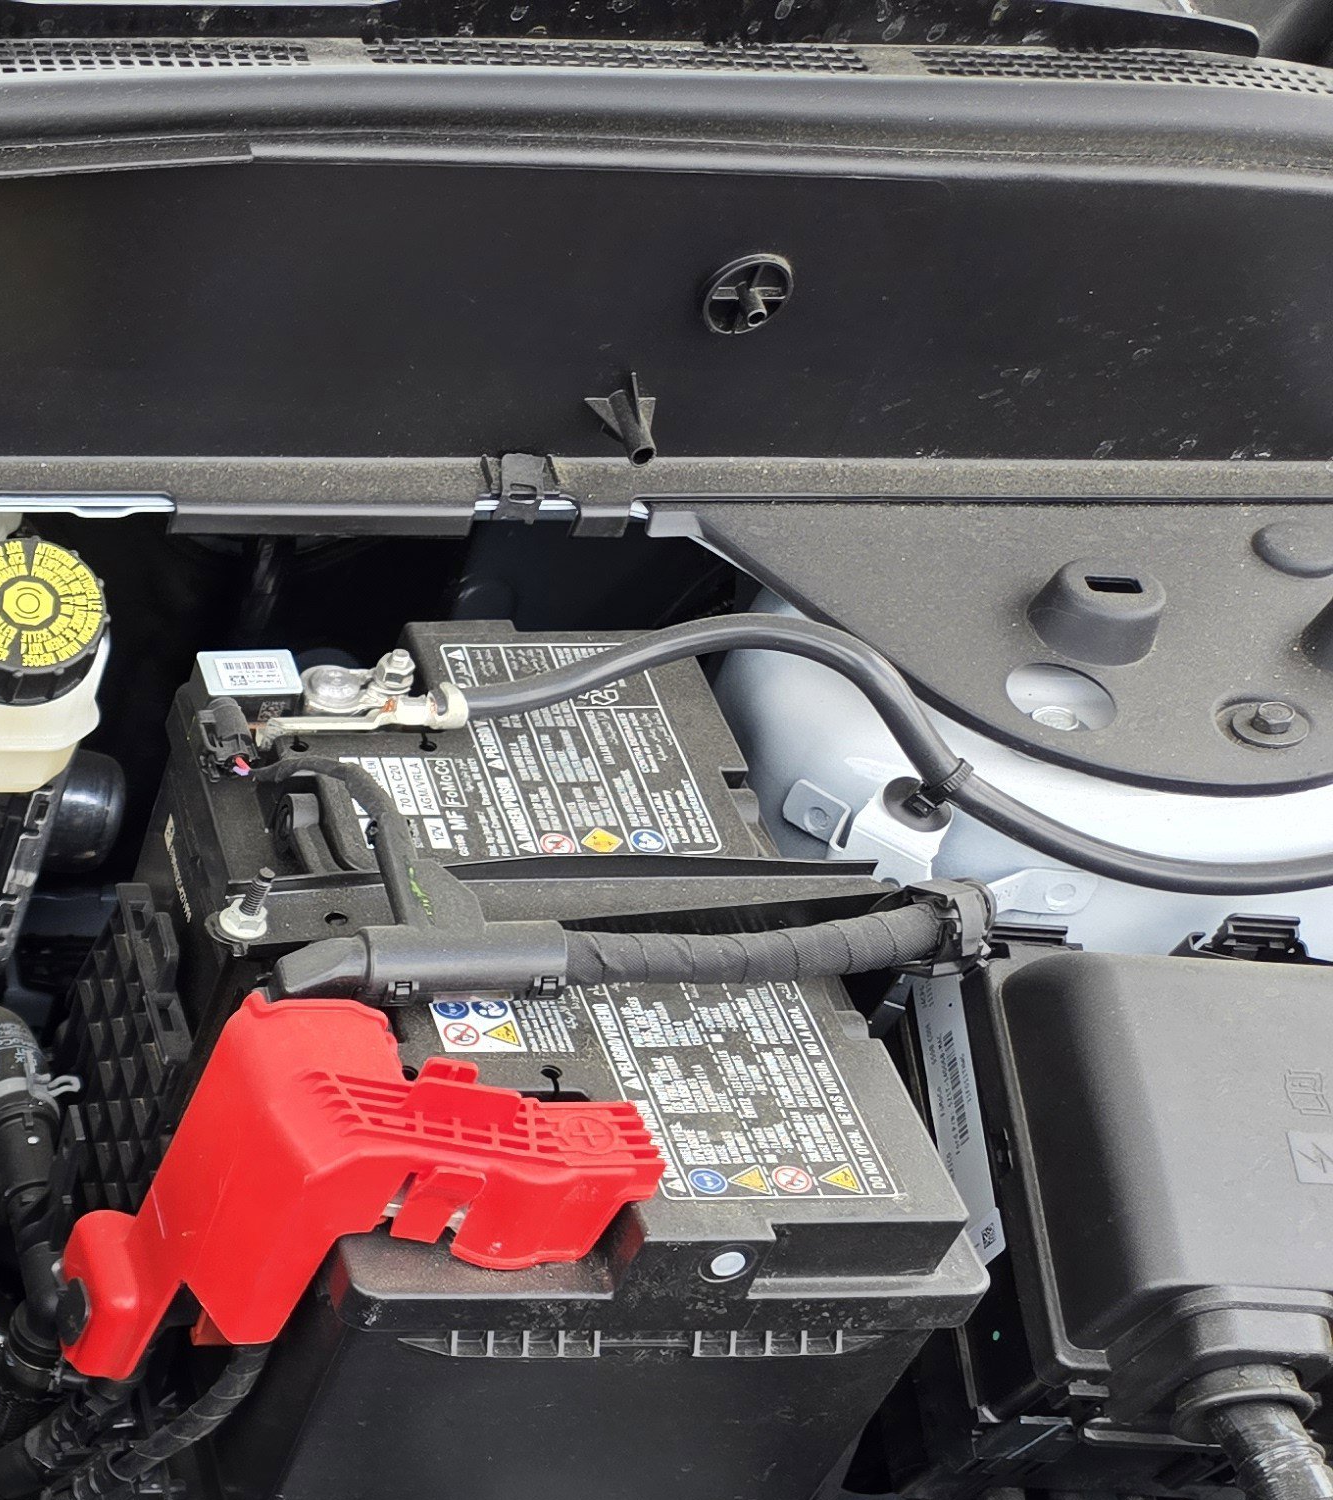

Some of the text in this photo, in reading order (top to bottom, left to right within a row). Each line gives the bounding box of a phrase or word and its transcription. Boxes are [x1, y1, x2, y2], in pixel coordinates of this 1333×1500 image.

[388, 765, 402, 780] C20
[431, 759, 456, 804] FoMoCo
[408, 762, 434, 810] AGM/VRLA
[399, 798, 412, 807] 70
[493, 776, 533, 840] DANGER/POISON
[444, 810, 468, 830] MF
[429, 824, 445, 840] 12V
[785, 1005, 810, 1029] ABRA.
[590, 1003, 637, 1076] PELIGRO/VENENO
[797, 1031, 815, 1041] LA
[803, 1043, 822, 1055] NO
[811, 1059, 840, 1093] OUVRIR.
[828, 1095, 850, 1112] PAS
[837, 1113, 856, 1124] NE
[844, 1129, 870, 1154] OPEN.
[857, 1156, 880, 1174] NOT
[867, 1175, 887, 1188] DO
